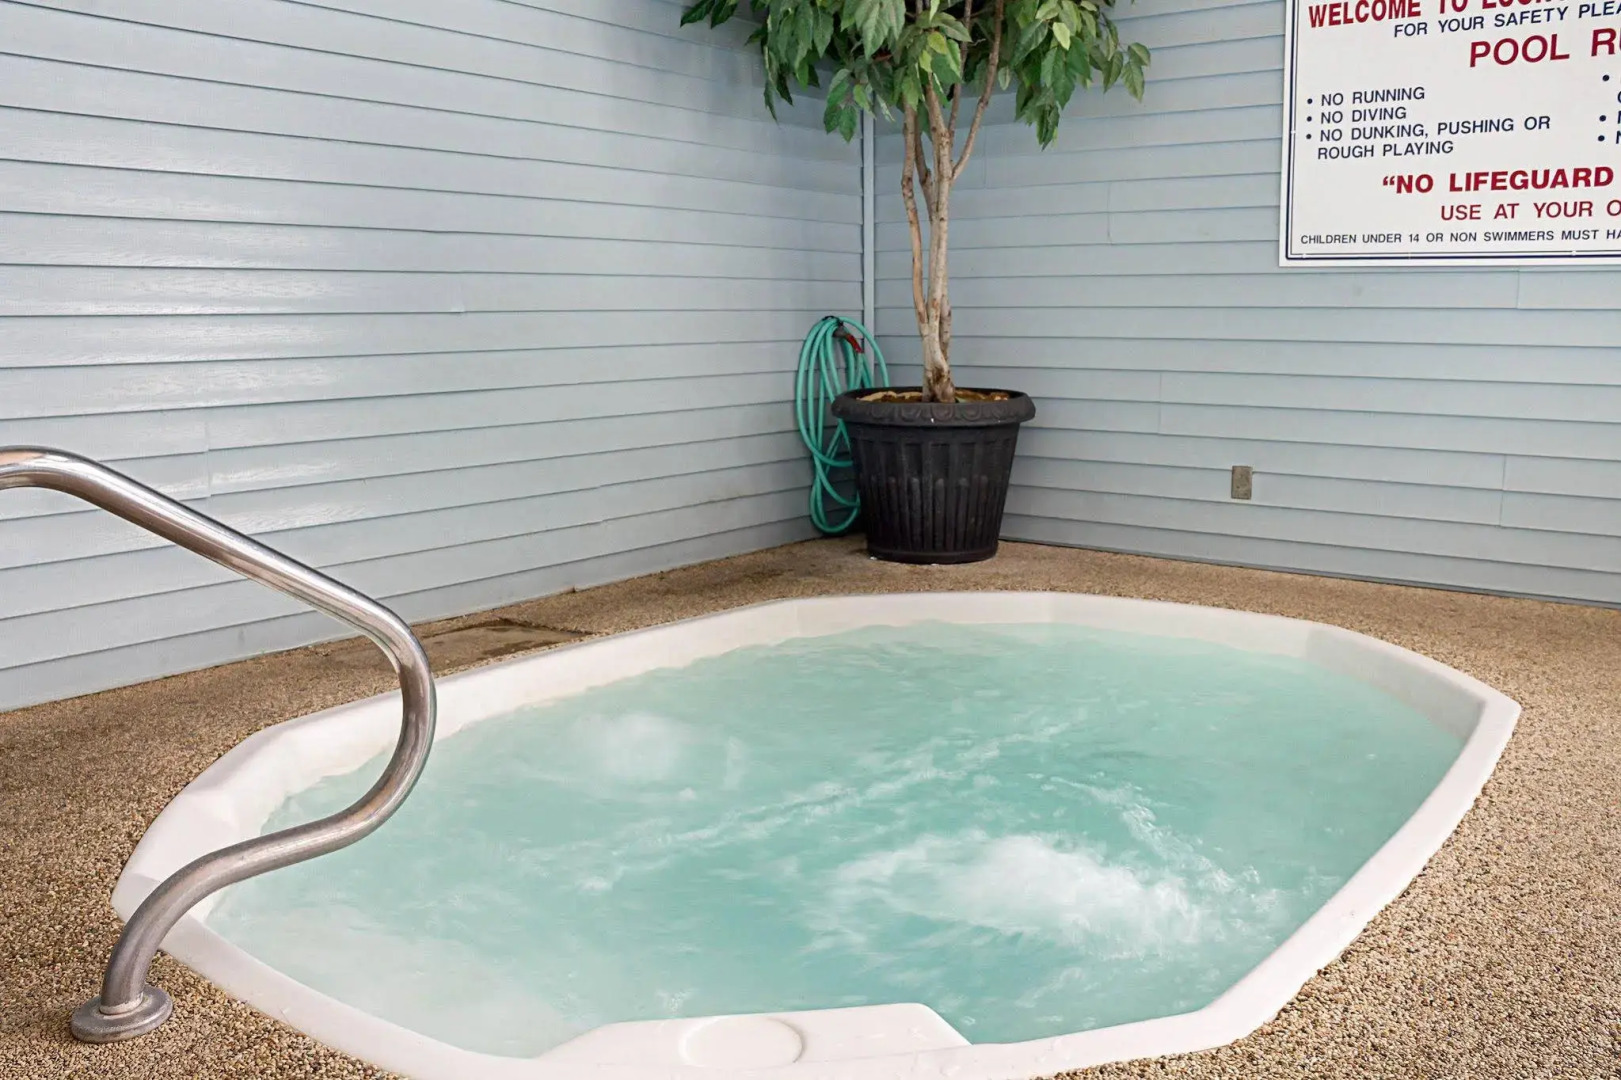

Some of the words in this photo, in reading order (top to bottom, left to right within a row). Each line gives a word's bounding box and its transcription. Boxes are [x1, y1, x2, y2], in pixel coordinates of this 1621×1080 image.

[1308, 0, 1422, 28] WELCOME
[1394, 22, 1428, 38] FOR
[1438, 16, 1484, 33] YOUR
[1494, 6, 1569, 27] SAFETY
[1470, 33, 1570, 68] POOL
[1321, 93, 1344, 106] NO
[1352, 86, 1425, 104] RUNNING
[1321, 111, 1343, 124] NO
[1352, 106, 1406, 122] DIVING
[1320, 128, 1342, 142] NO
[1351, 123, 1428, 140] DUNKING,
[1437, 118, 1514, 135] PUSHING
[1524, 116, 1550, 130] OR
[1318, 145, 1374, 160] ROUGH
[1383, 140, 1453, 157] PLAYING
[1449, 166, 1614, 192] LIFEGUARD
[1441, 204, 1481, 221] USE
[1494, 203, 1520, 219] AT
[1533, 201, 1593, 218] YOUR
[1301, 234, 1357, 244] CHILDREN
[1362, 233, 1402, 243] UNDER
[1409, 234, 1419, 242] 14
[1426, 233, 1443, 242] OR
[1450, 232, 1477, 242] NON
[1484, 230, 1554, 242] SWIMMERS
[1561, 229, 1599, 240] MUST
